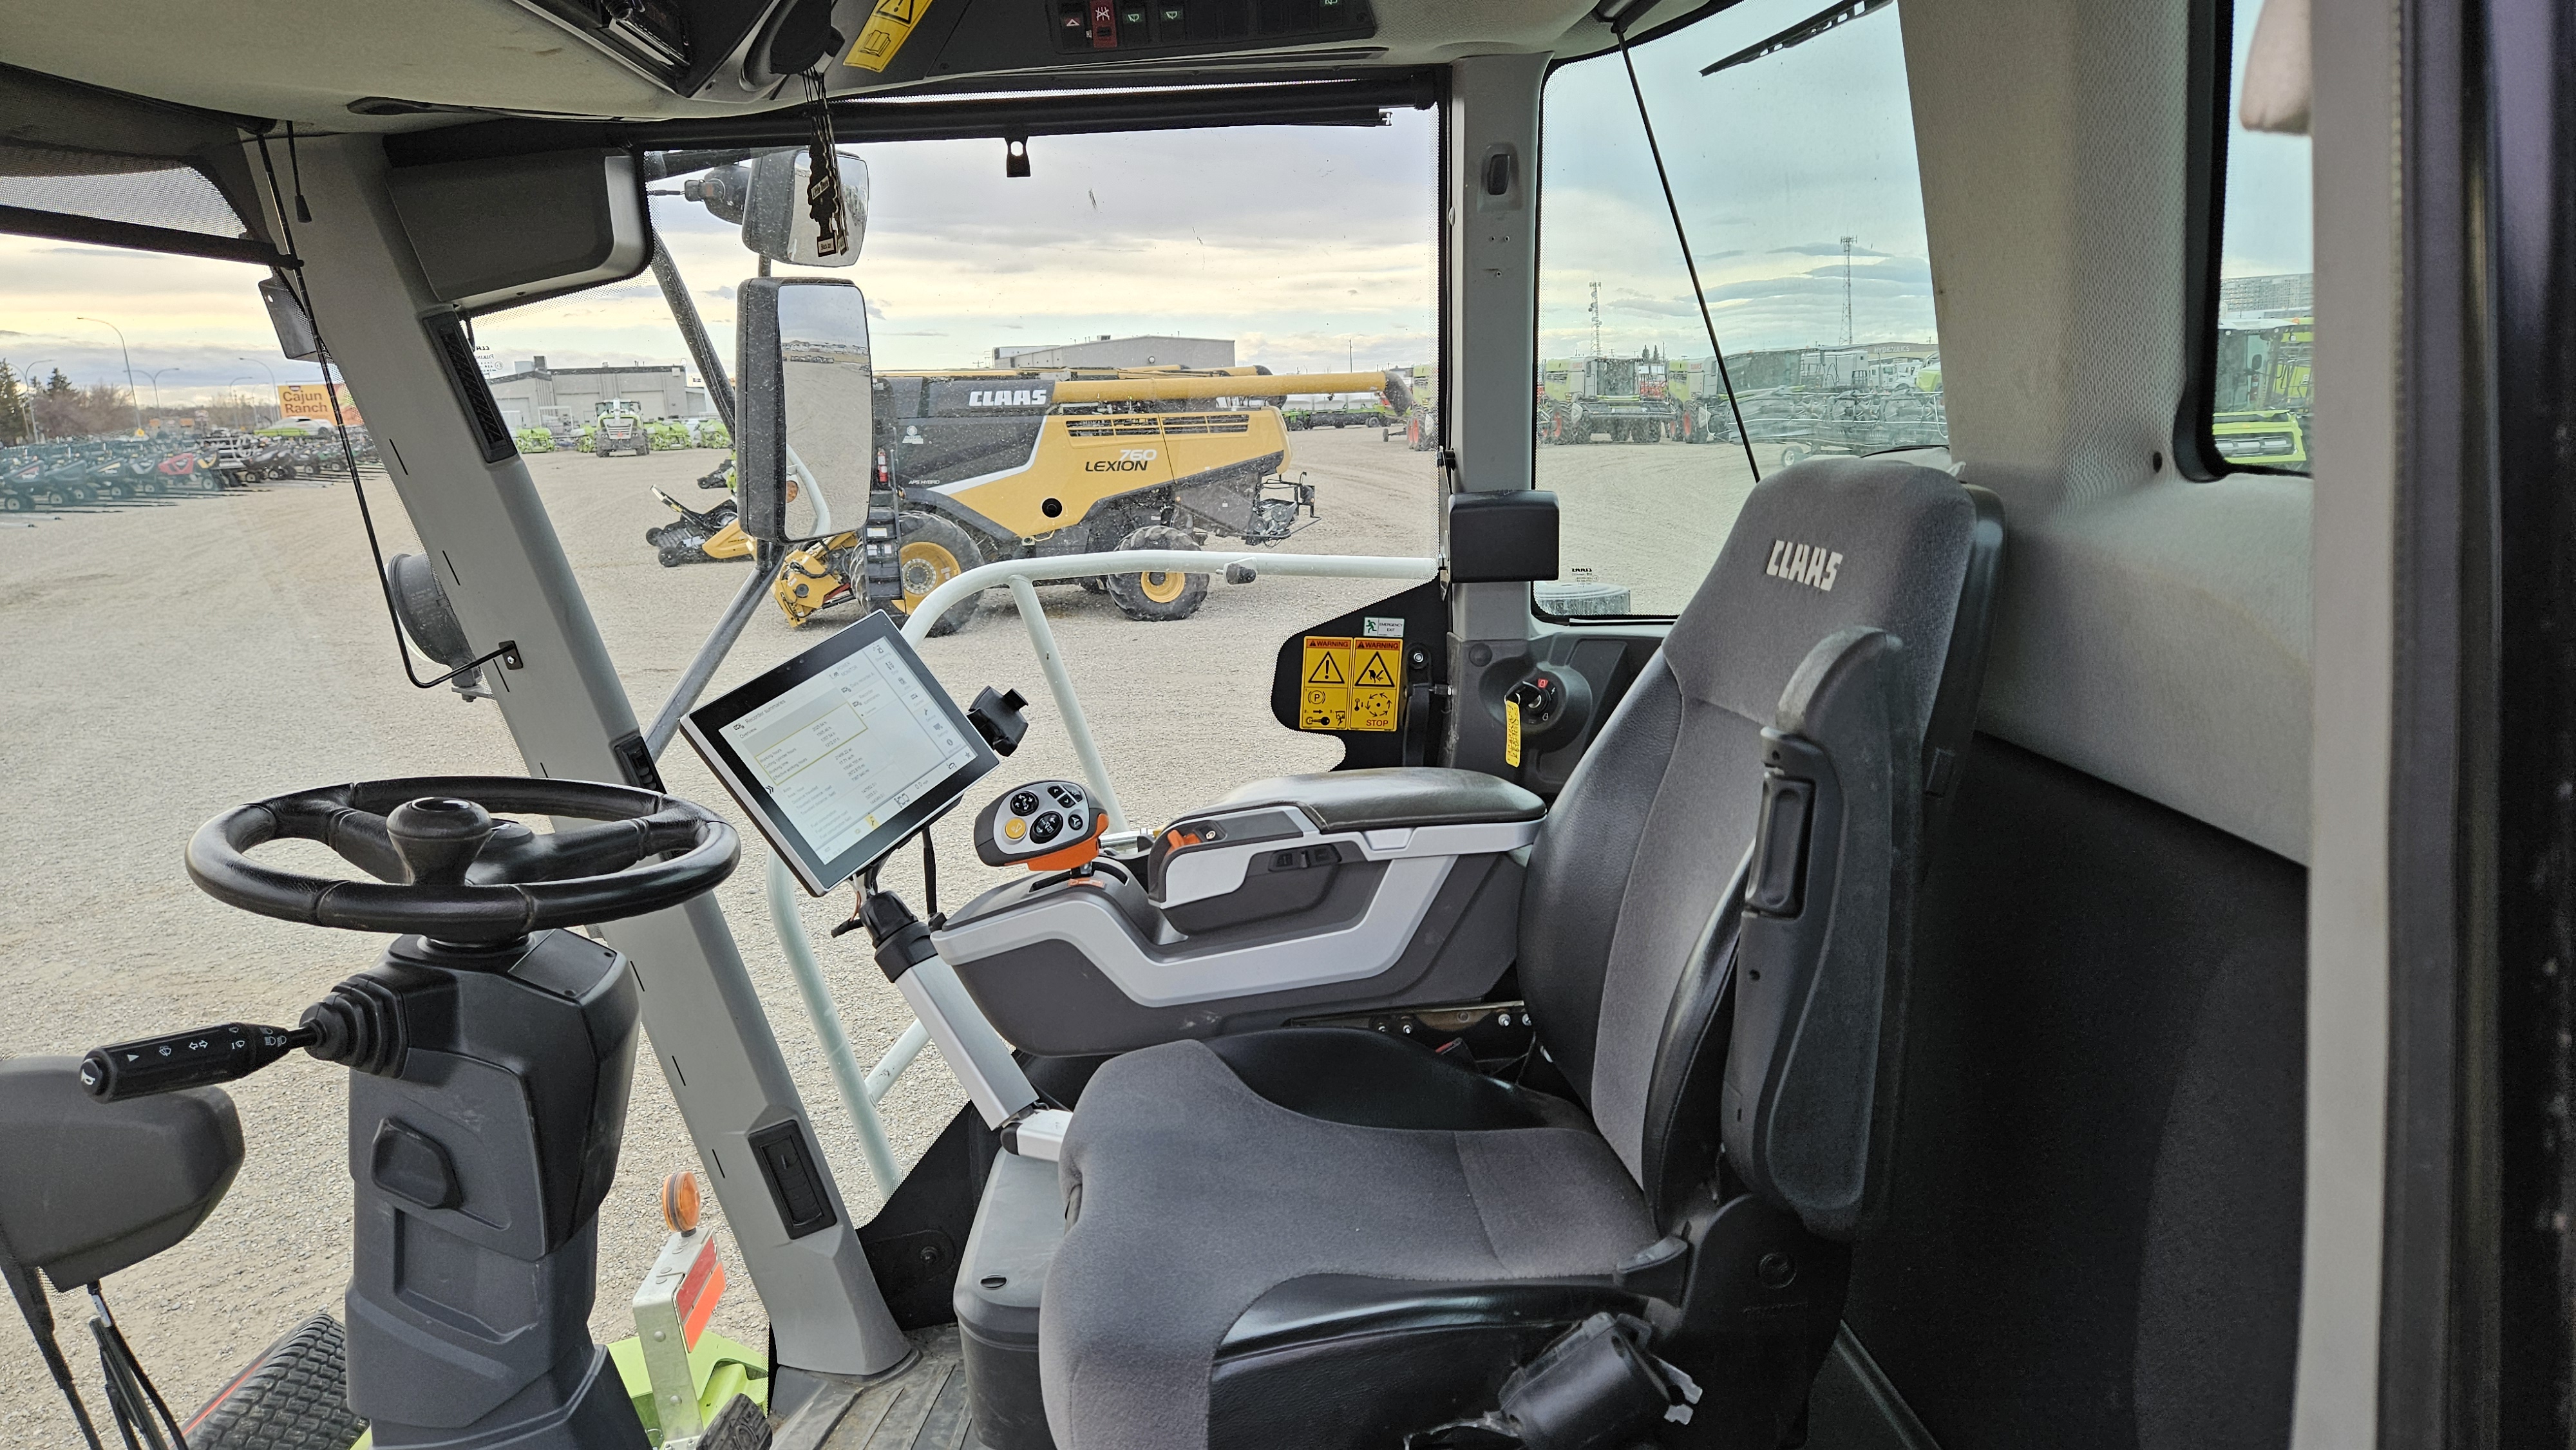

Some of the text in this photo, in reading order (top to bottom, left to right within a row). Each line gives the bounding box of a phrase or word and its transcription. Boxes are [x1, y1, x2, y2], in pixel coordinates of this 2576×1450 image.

[1874, 345, 1910, 353] HYDRAULICS
[283, 390, 322, 404] Cajun
[969, 390, 1046, 406] CLAAS
[285, 402, 327, 413] Ranch
[1119, 449, 1157, 461] 760
[1085, 460, 1148, 472] LEXION
[1766, 540, 1843, 592] CLAAS
[837, 661, 851, 672] POWER
[840, 665, 858, 677] MONITOR
[744, 699, 786, 724] Recorder summaries
[739, 726, 757, 739] Overview
